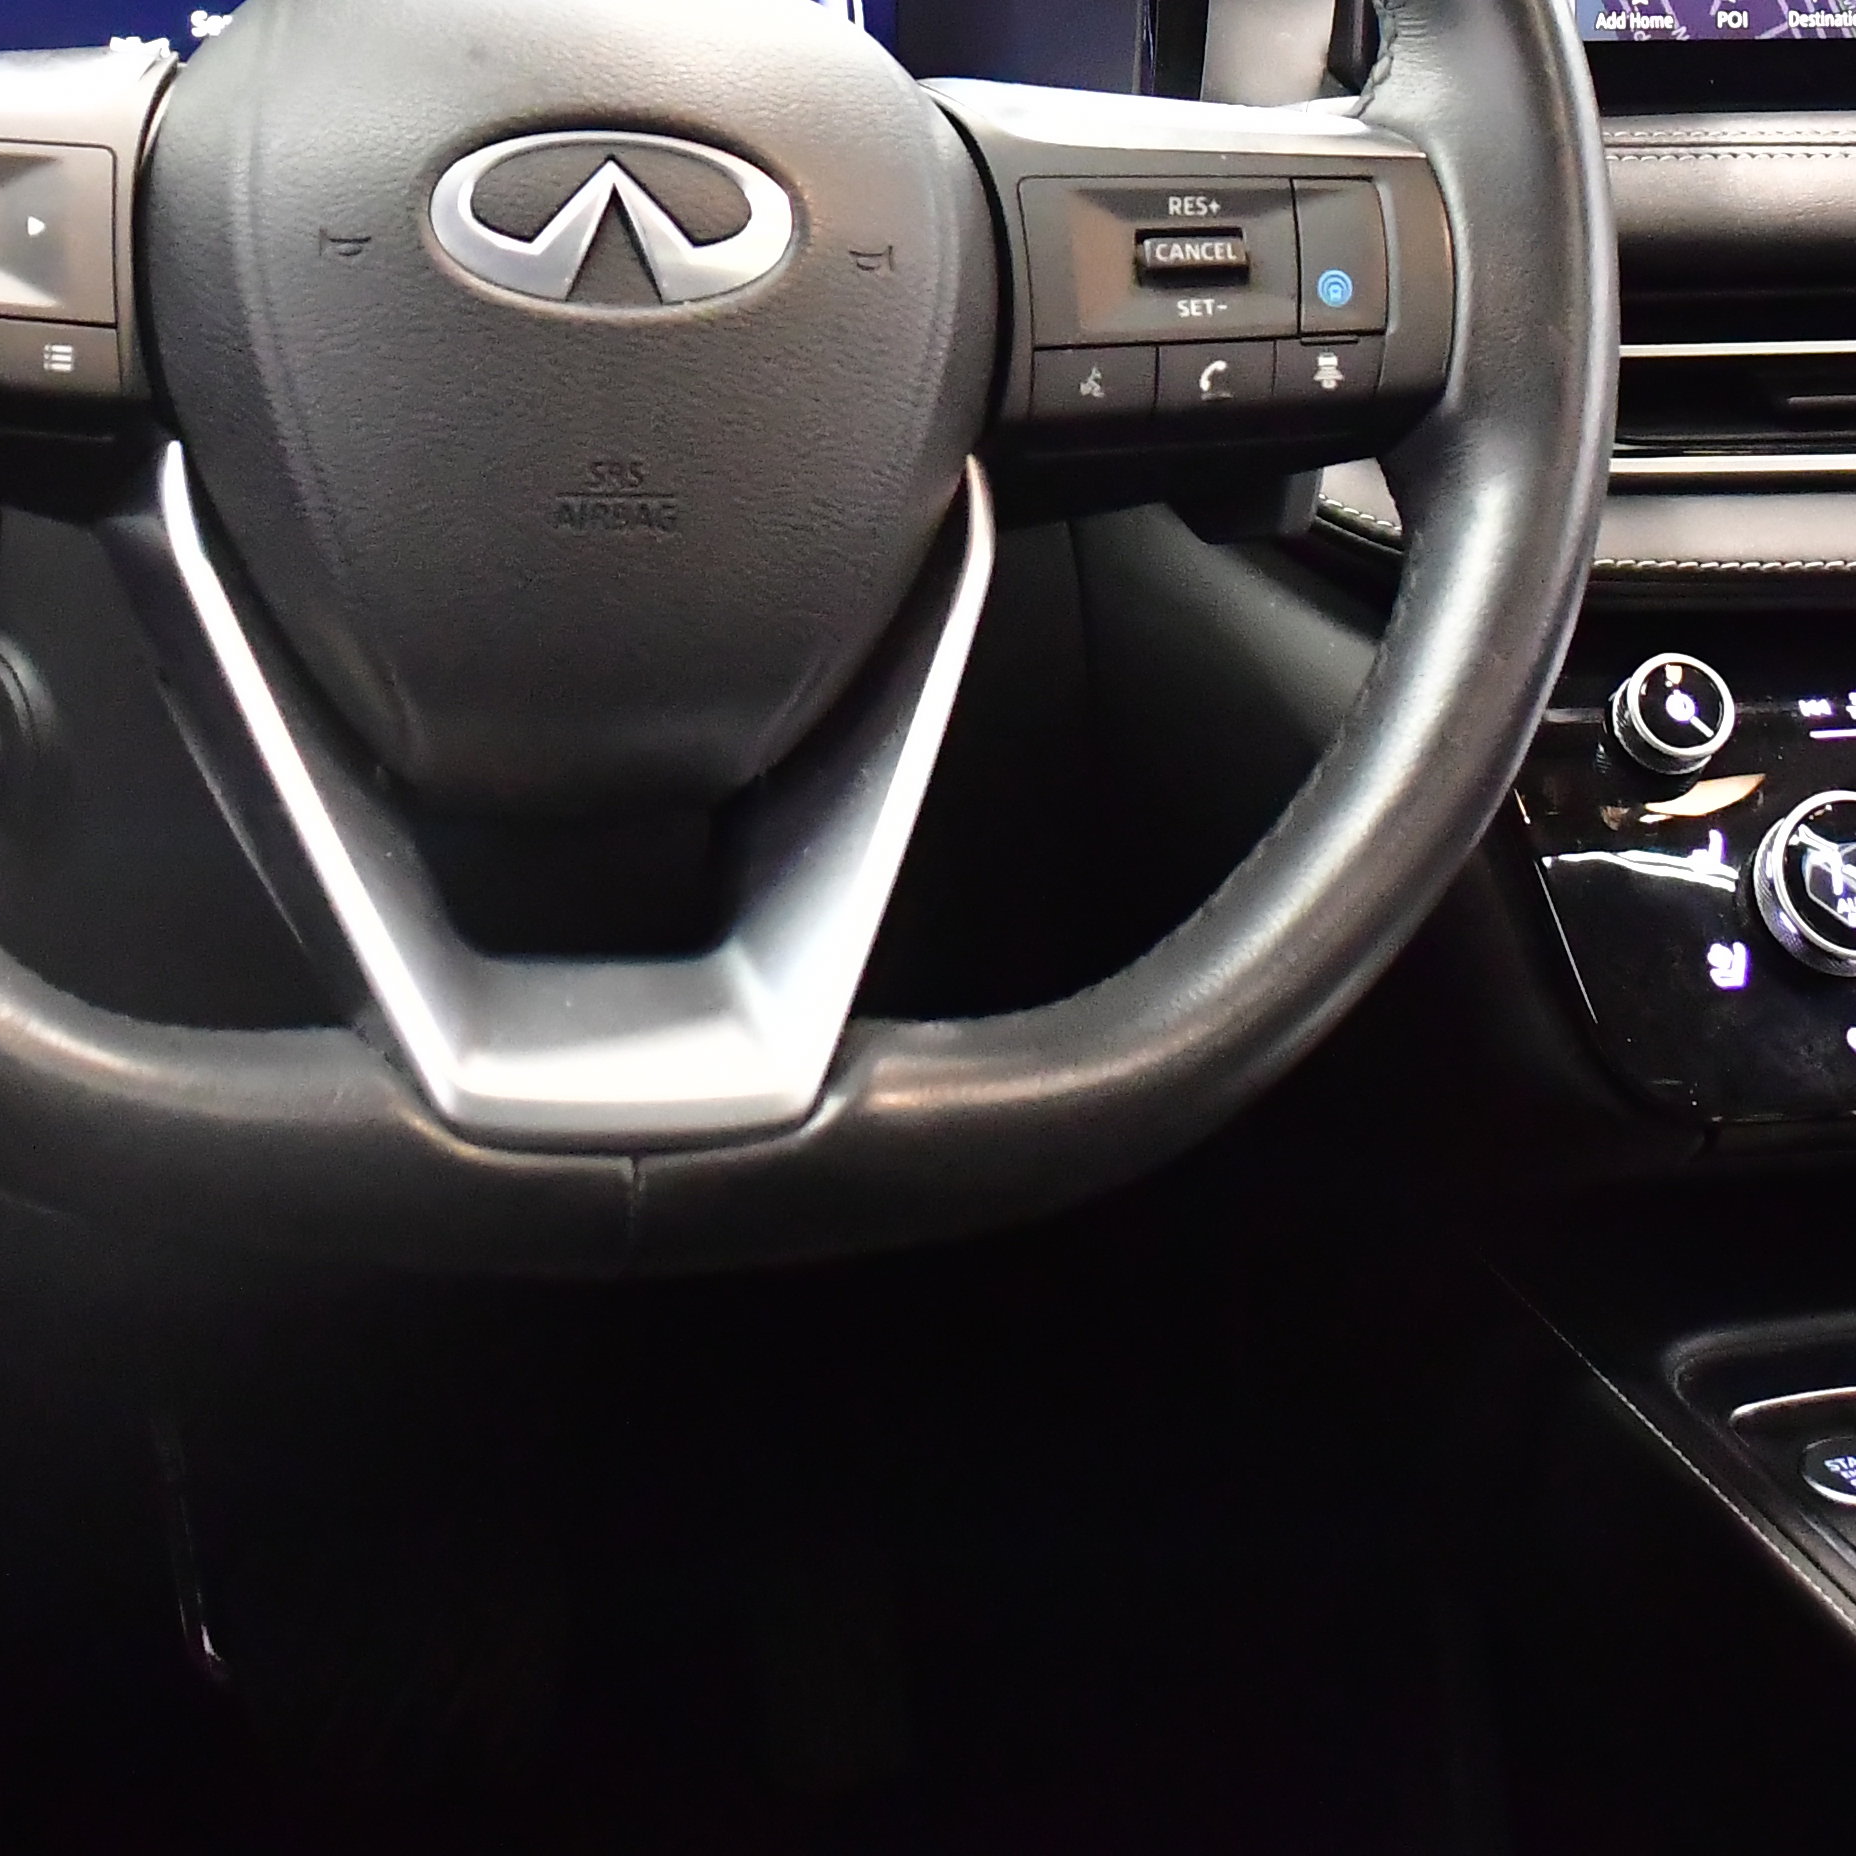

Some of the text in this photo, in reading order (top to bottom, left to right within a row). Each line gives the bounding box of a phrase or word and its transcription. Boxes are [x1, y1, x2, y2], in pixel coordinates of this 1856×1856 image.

[1595, 11, 1675, 31] Add Home
[1716, 10, 1748, 29] POI
[1168, 196, 1222, 216] RES+
[1155, 242, 1238, 263] CANCEL
[1177, 298, 1228, 318] SET-
